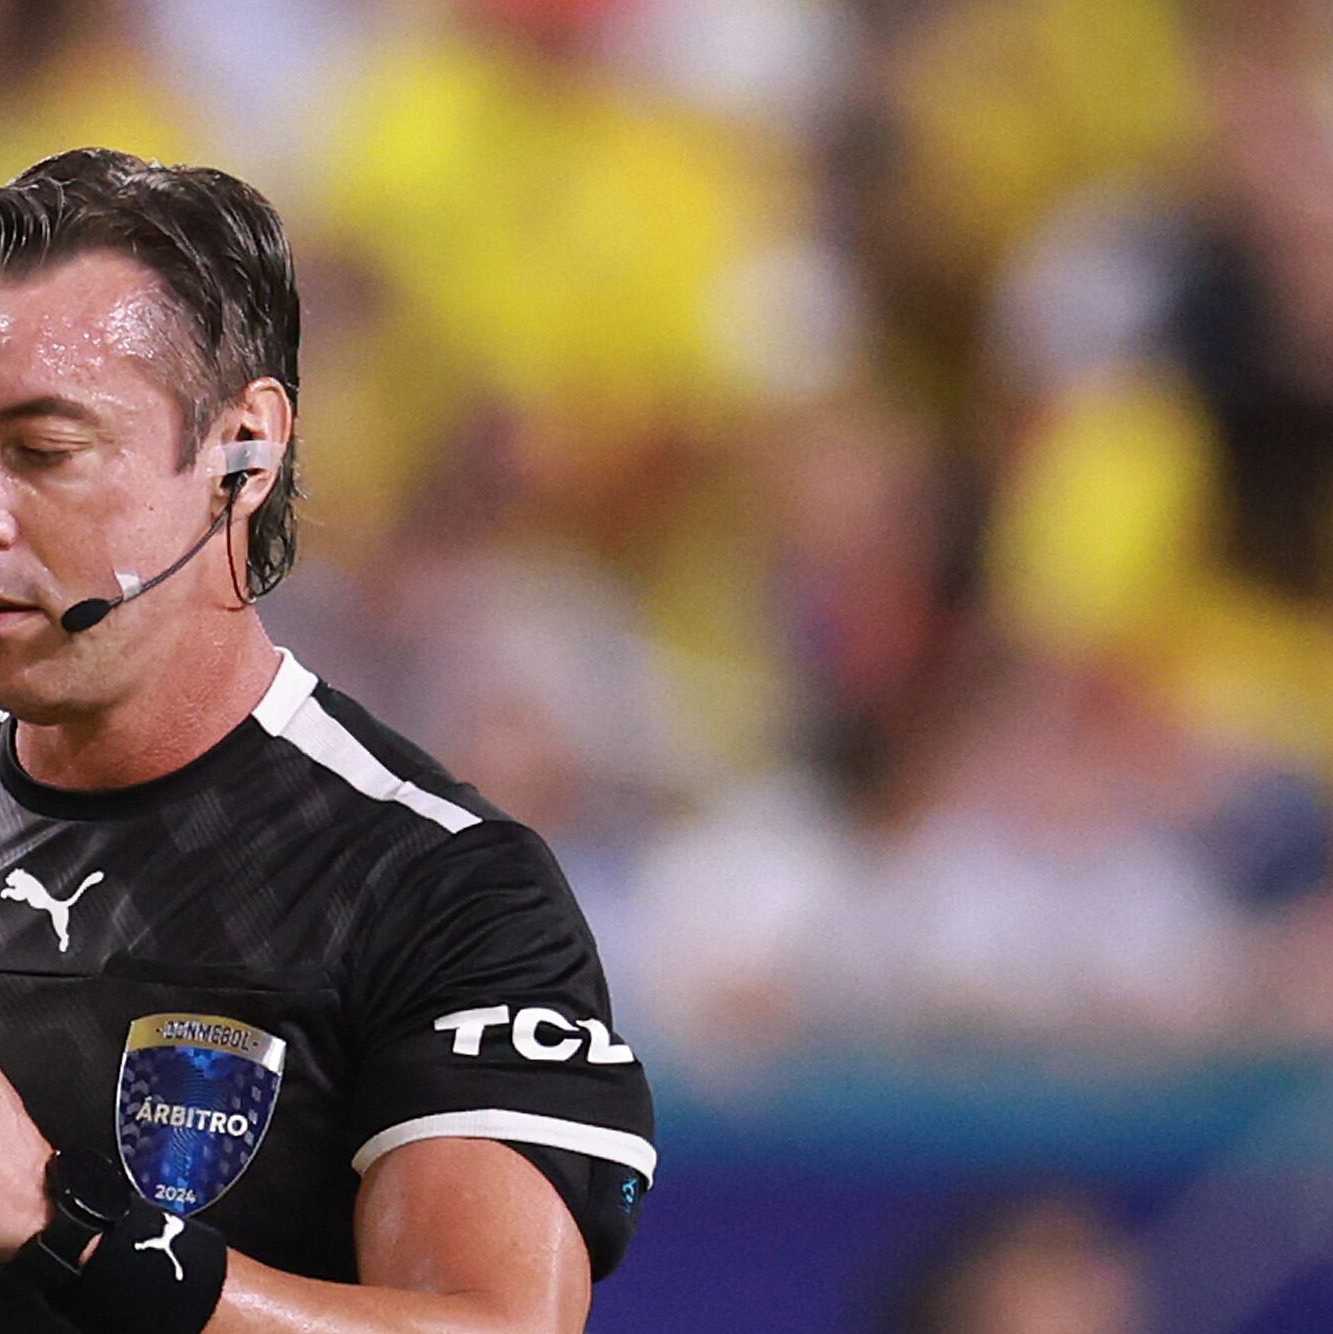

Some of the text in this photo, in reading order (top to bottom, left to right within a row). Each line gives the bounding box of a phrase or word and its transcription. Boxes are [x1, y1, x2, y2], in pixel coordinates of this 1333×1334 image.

[433, 1004, 635, 1064] TCL
[135, 1095, 249, 1137] ÁRBITRO
[154, 1184, 197, 1205] 2024
